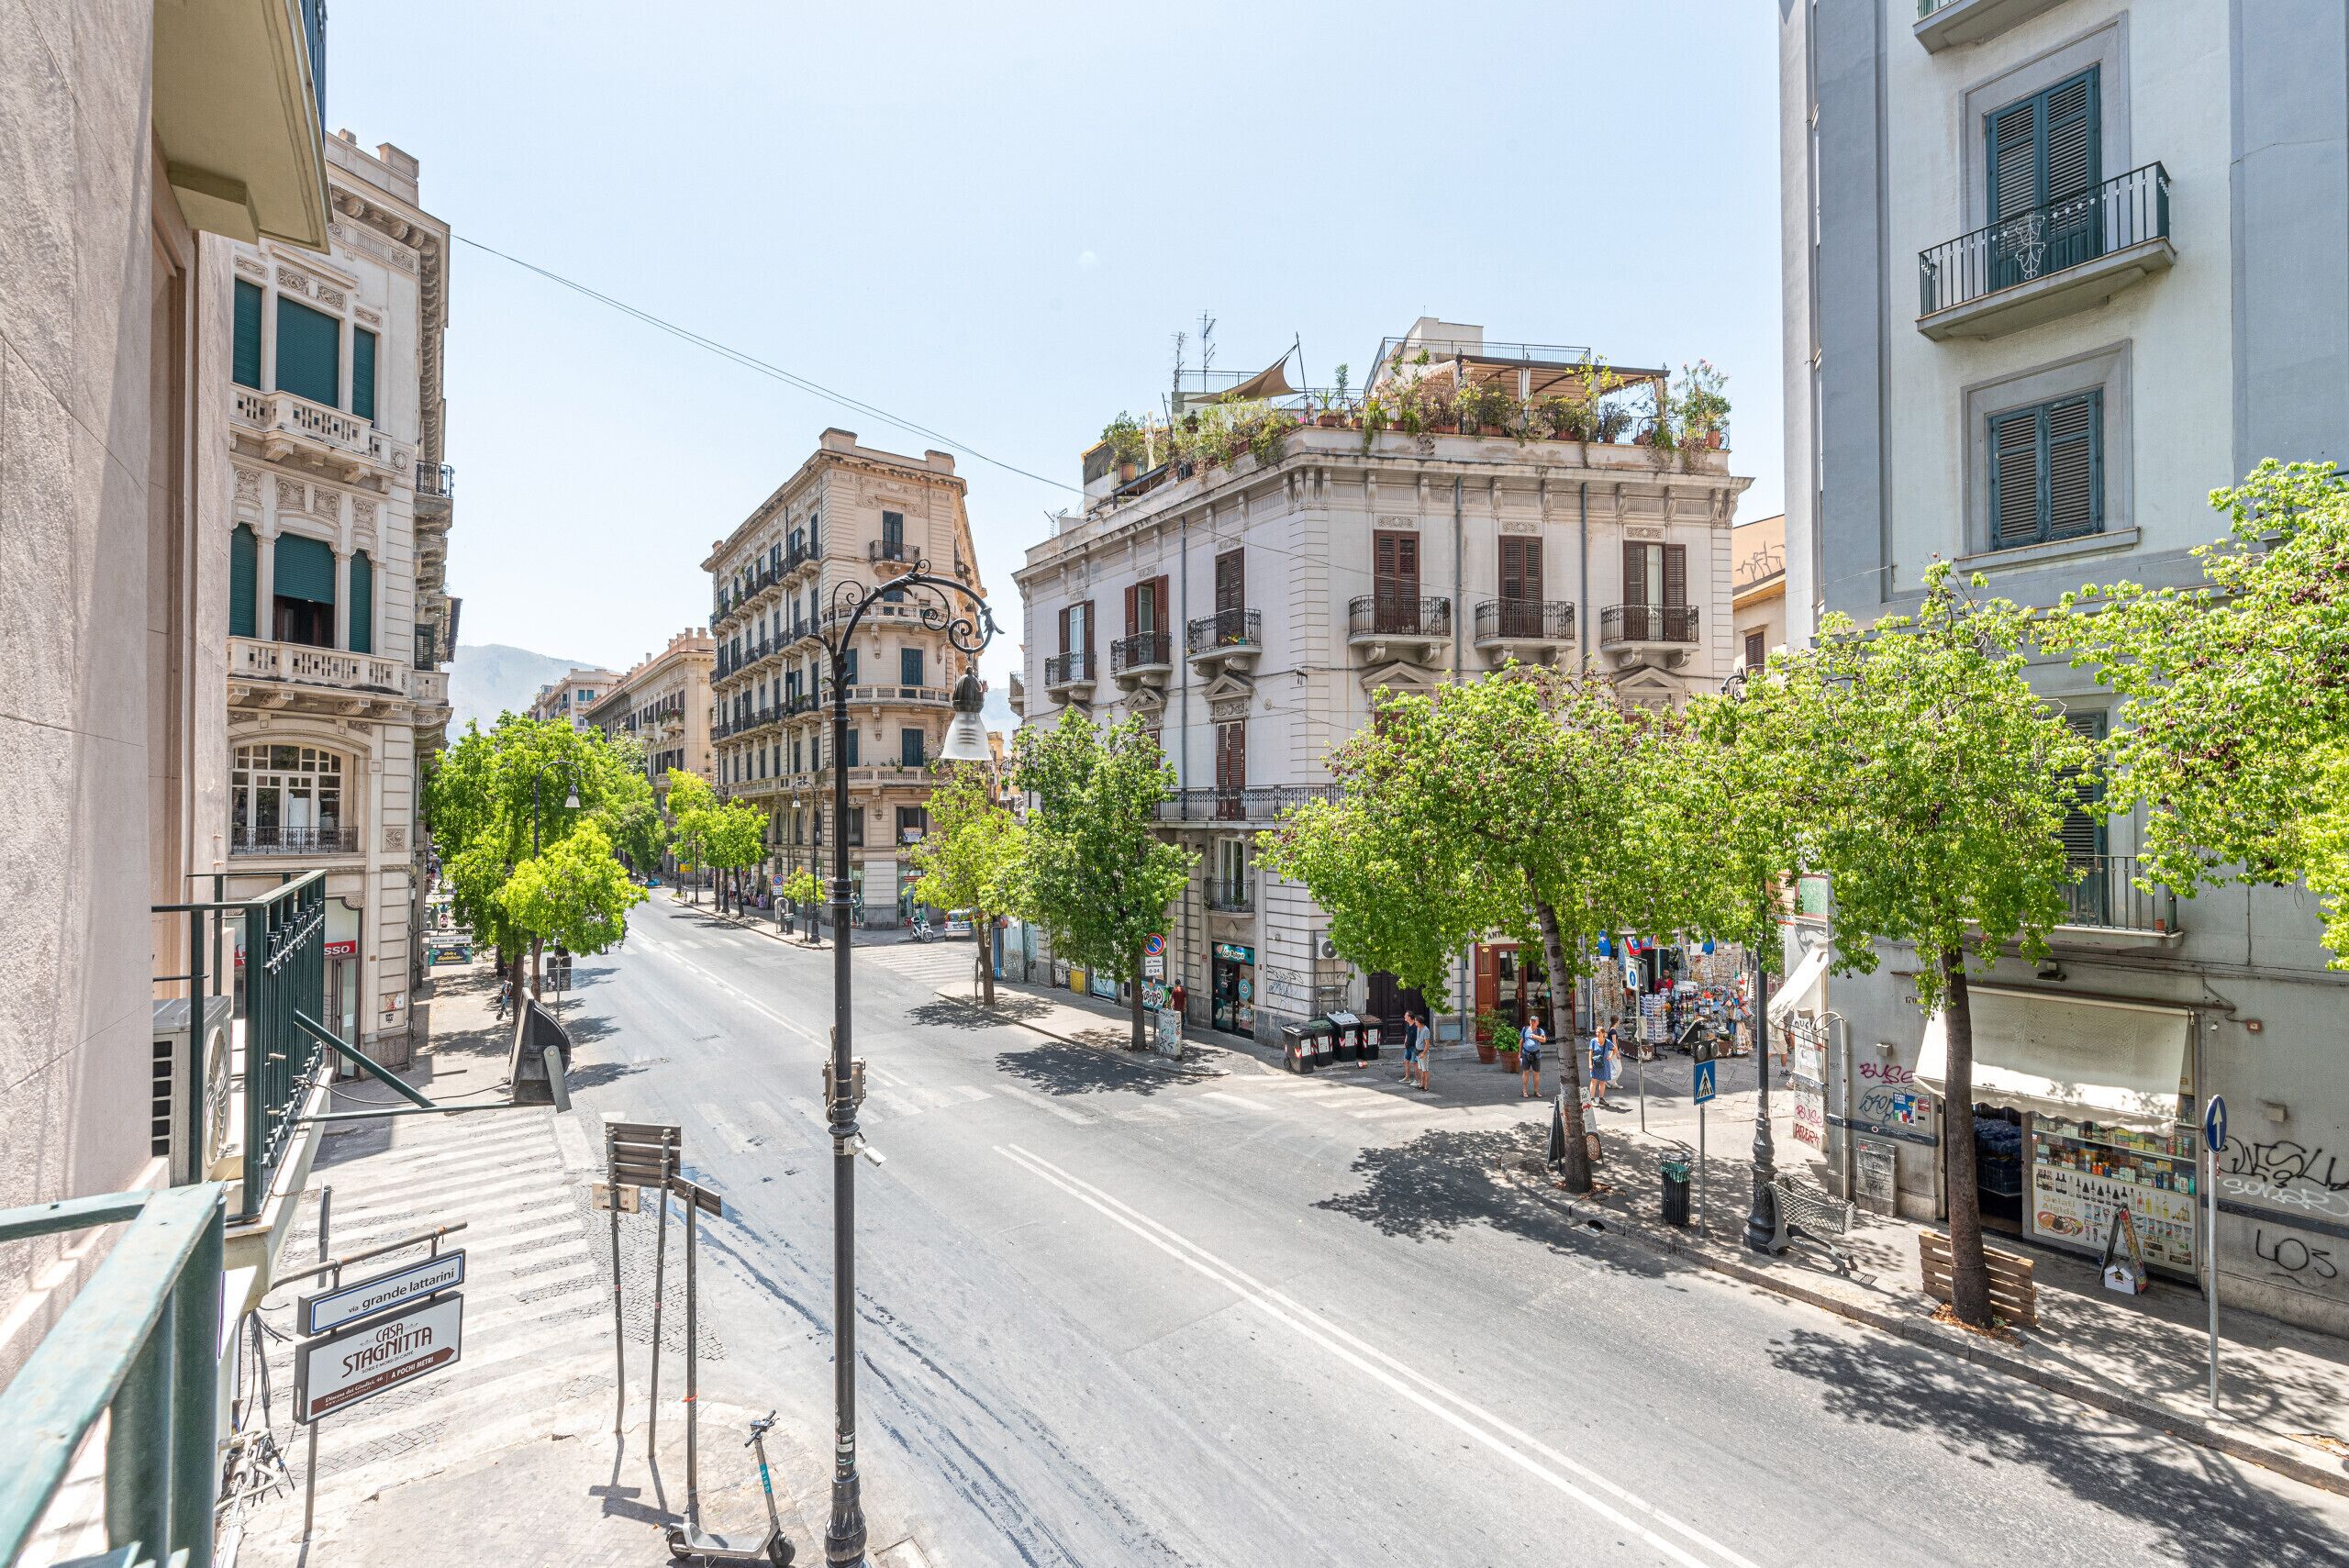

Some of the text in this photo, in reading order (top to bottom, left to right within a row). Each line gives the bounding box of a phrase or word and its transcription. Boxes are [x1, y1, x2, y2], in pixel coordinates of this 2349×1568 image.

[362, 1285, 406, 1311] grande
[408, 1267, 454, 1293] lattarini
[375, 1323, 404, 1343] CASA
[341, 1326, 433, 1378] STAGNITTA
[362, 1365, 375, 1374] SORSI
[391, 1356, 434, 1379] A POCHI METRI
[325, 1392, 345, 1404] Discesa
